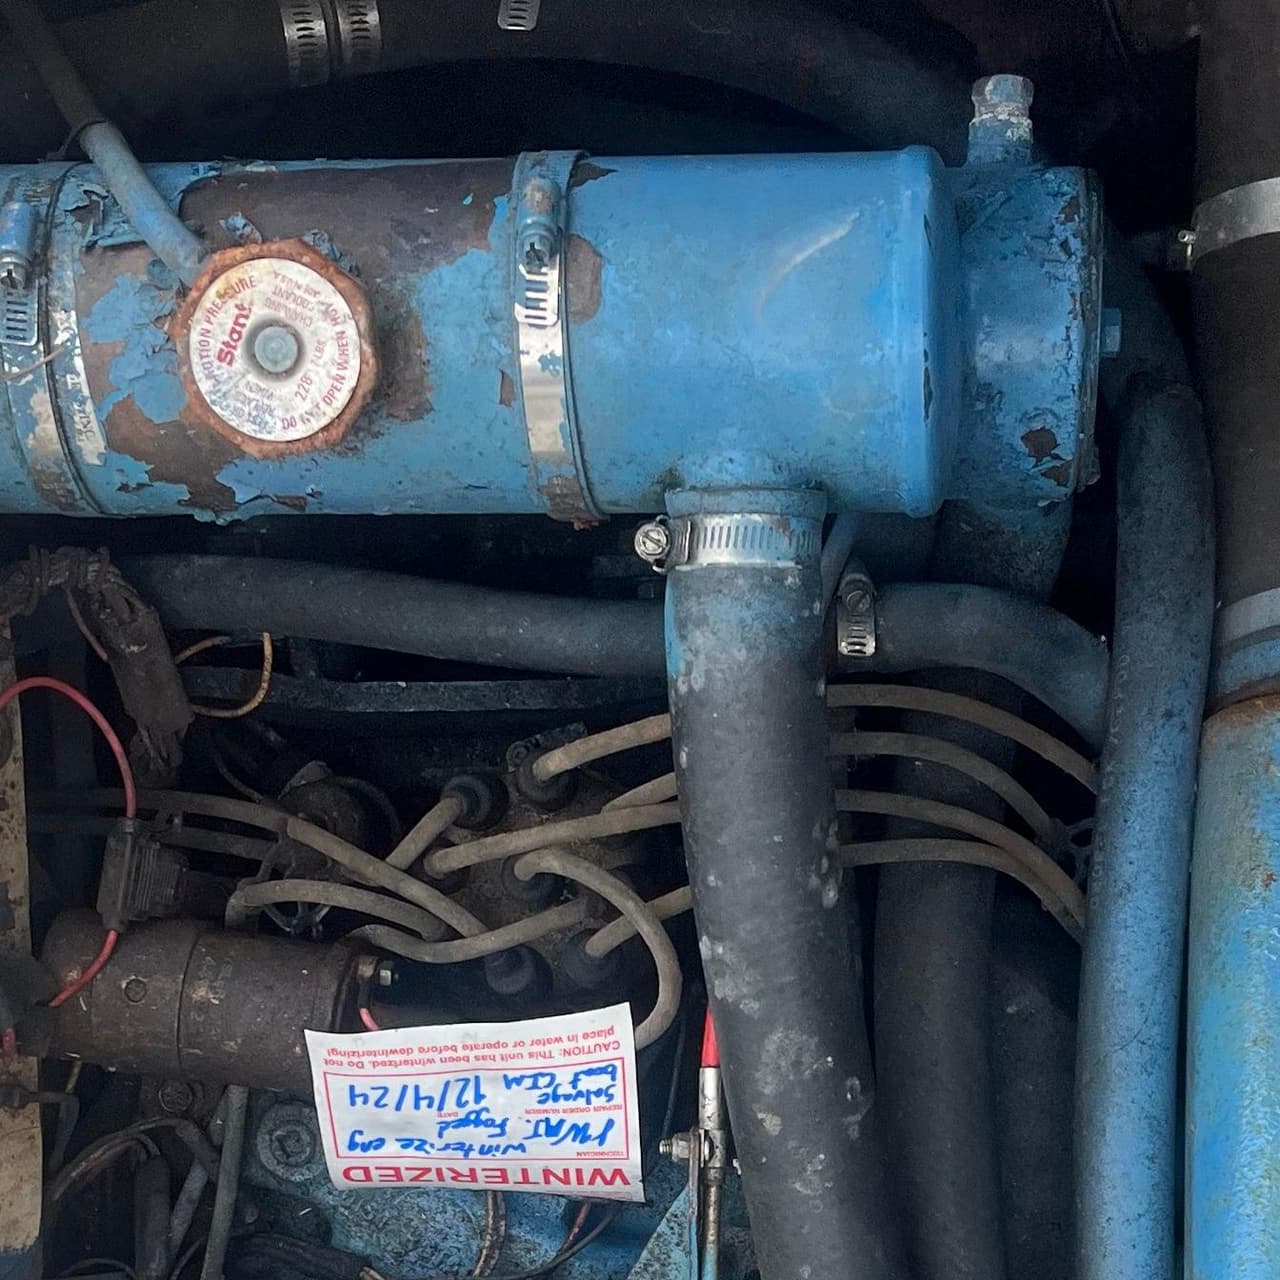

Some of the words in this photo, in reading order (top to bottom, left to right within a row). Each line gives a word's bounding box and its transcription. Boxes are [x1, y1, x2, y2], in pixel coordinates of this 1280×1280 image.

[217, 303, 251, 366] Stant
[282, 417, 297, 429] DO
[322, 371, 343, 405] OPEN
[335, 331, 349, 372] WHEN
[582, 1025, 615, 1039] place
[530, 1036, 563, 1046] water
[567, 1034, 578, 1043] in
[418, 1045, 458, 1055] before
[462, 1042, 508, 1052] operate
[560, 1040, 620, 1058] CAUTION:
[327, 1048, 414, 1058] dewinterizing!
[500, 1052, 524, 1063] unit
[528, 1049, 555, 1059] This
[322, 1058, 343, 1067] not
[368, 1057, 436, 1069] winterized.
[440, 1055, 470, 1064] been
[474, 1054, 496, 1063] has
[348, 1060, 365, 1069] Do
[348, 1075, 486, 1112] 12/4/24
[593, 1104, 622, 1112] REPAIR
[347, 1130, 386, 1153] eng
[394, 1138, 526, 1158] winterize
[342, 1166, 630, 1185] WINTERIZED
